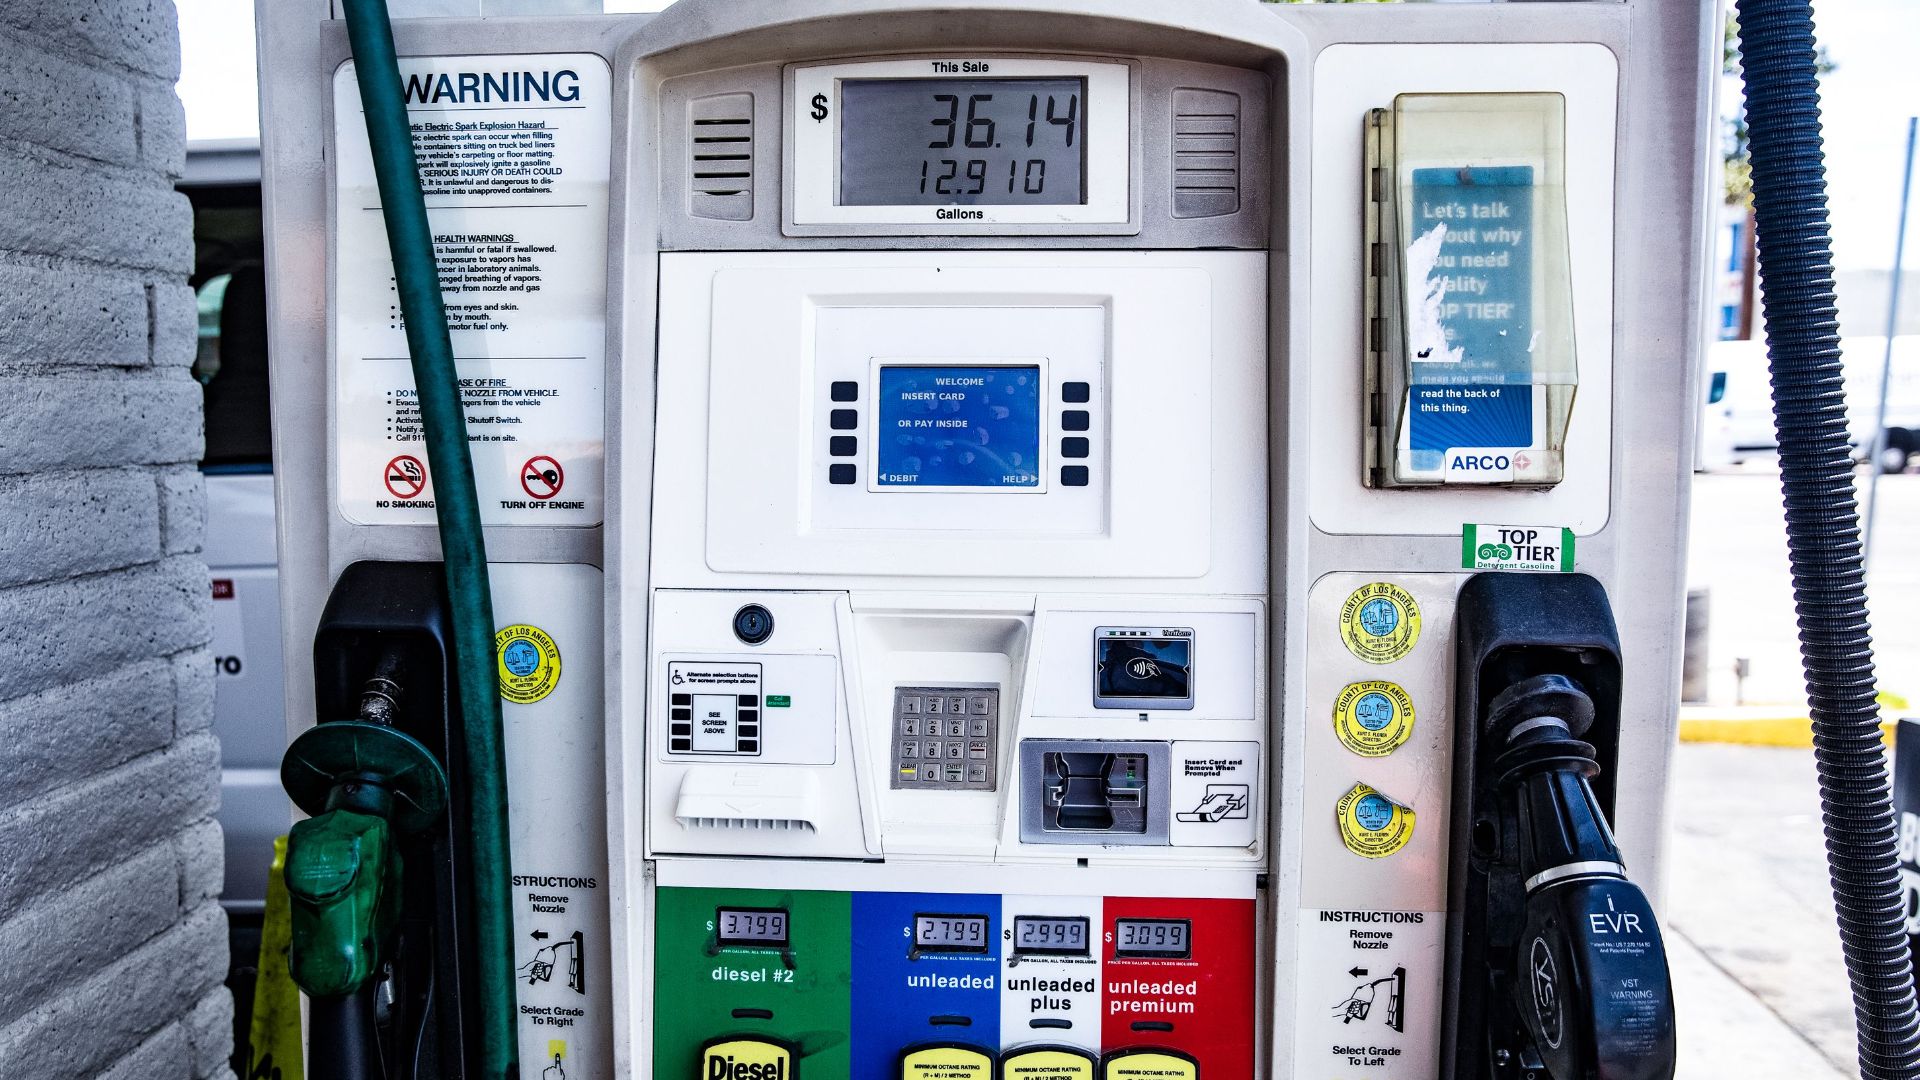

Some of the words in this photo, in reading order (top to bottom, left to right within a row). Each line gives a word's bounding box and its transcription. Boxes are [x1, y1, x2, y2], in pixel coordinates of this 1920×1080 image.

[932, 62, 960, 73] This
[963, 62, 989, 73] Sale
[399, 69, 580, 104] WARNING
[810, 92, 829, 123] $
[425, 123, 453, 131] Electric
[455, 122, 478, 132] Spark
[480, 121, 516, 131] Explosion
[518, 121, 545, 129] Hazard
[928, 94, 1078, 148] 36.14
[424, 169, 459, 177] SERIOUS
[505, 168, 531, 176] DEATH
[920, 159, 1046, 195] 12.910
[936, 209, 984, 220] Gallons
[1423, 202, 1467, 218] Let's
[1472, 202, 1510, 218] talk
[434, 235, 466, 243] HEALTH
[467, 234, 514, 242] WARNINGS
[1482, 227, 1522, 246] why
[437, 246, 443, 254] is
[445, 246, 475, 254] harmful
[487, 245, 504, 253] fatal
[506, 245, 511, 253] if
[513, 245, 557, 253] swallowed.
[1461, 251, 1510, 268] need
[440, 285, 461, 293] away
[462, 284, 480, 292] from
[482, 284, 507, 292] nozzle
[526, 285, 540, 293] gas
[444, 303, 462, 311] from
[463, 304, 482, 312] eyes
[484, 303, 499, 311] and
[501, 303, 519, 311] skin.
[473, 322, 488, 330] fuel
[490, 323, 509, 331] only.
[475, 379, 487, 387] OF
[489, 379, 507, 387] FIRE
[935, 378, 984, 386] WELCOME
[901, 392, 936, 400] INSERT
[939, 392, 965, 401] CARD
[1421, 390, 1444, 398] read
[1445, 389, 1462, 398] the
[1464, 389, 1488, 398] back
[1490, 389, 1500, 398] of
[1421, 404, 1440, 412] this
[1442, 404, 1470, 414] thing.
[898, 420, 911, 428] OR
[914, 420, 933, 428] PAY
[935, 420, 968, 428] INSIDE
[1451, 456, 1509, 470] ARCO
[1002, 475, 1028, 483] HELP
[376, 501, 389, 509] NO
[391, 501, 435, 509] SMOKING
[501, 501, 526, 509] TURN
[529, 501, 547, 509] OFF
[1498, 529, 1538, 544] TOP
[1477, 562, 1517, 570] Detergent
[1520, 562, 1555, 570] Gasoline
[1342, 594, 1361, 624] COUNTY
[1361, 588, 1371, 597] OF
[1373, 586, 1390, 594] LOS
[1391, 589, 1417, 618] ANGELES
[504, 630, 514, 639] OF
[532, 630, 556, 659] ANGELES
[908, 703, 913, 711] 1
[1338, 686, 1360, 712] COUNTY
[1390, 688, 1412, 717] ANGELES
[930, 704, 937, 712] 2
[953, 704, 960, 712] 3
[930, 726, 936, 734] 5
[953, 726, 959, 734] 6
[929, 748, 935, 756] 8
[951, 748, 958, 756] 9
[513, 875, 597, 889] STRUCTIONS
[529, 894, 569, 903] Remove
[532, 904, 566, 913] Nozzle
[1320, 911, 1424, 923] INSTRUCTIONS
[706, 920, 713, 931] $
[727, 915, 782, 935] 3.799
[1589, 913, 1643, 934] EVR
[903, 925, 911, 938] $
[923, 920, 980, 941] 2.799
[1003, 929, 1011, 940] $
[1023, 923, 1080, 944] 2.999
[1105, 932, 1112, 944] $
[1124, 925, 1181, 946] 3.099
[1350, 929, 1393, 939] Remove
[1353, 940, 1389, 949] Nozzle
[711, 966, 766, 982] diesel
[773, 968, 794, 983] #2
[907, 973, 994, 989] unleaded
[1007, 976, 1095, 992] unleaded
[1621, 978, 1638, 988] VST
[1109, 979, 1197, 995] unleaded
[1610, 990, 1653, 999] WARNING
[1031, 995, 1071, 1013] plus
[1110, 998, 1194, 1015] premium
[520, 1005, 552, 1015] Select
[553, 1006, 585, 1017] Grade
[532, 1016, 544, 1025] To
[547, 1016, 574, 1027] Right
[1332, 1045, 1365, 1055] Select
[1368, 1046, 1401, 1056] Grade
[1348, 1056, 1361, 1066] To
[1364, 1057, 1385, 1066] Left
[708, 1055, 784, 1080] Diesel
